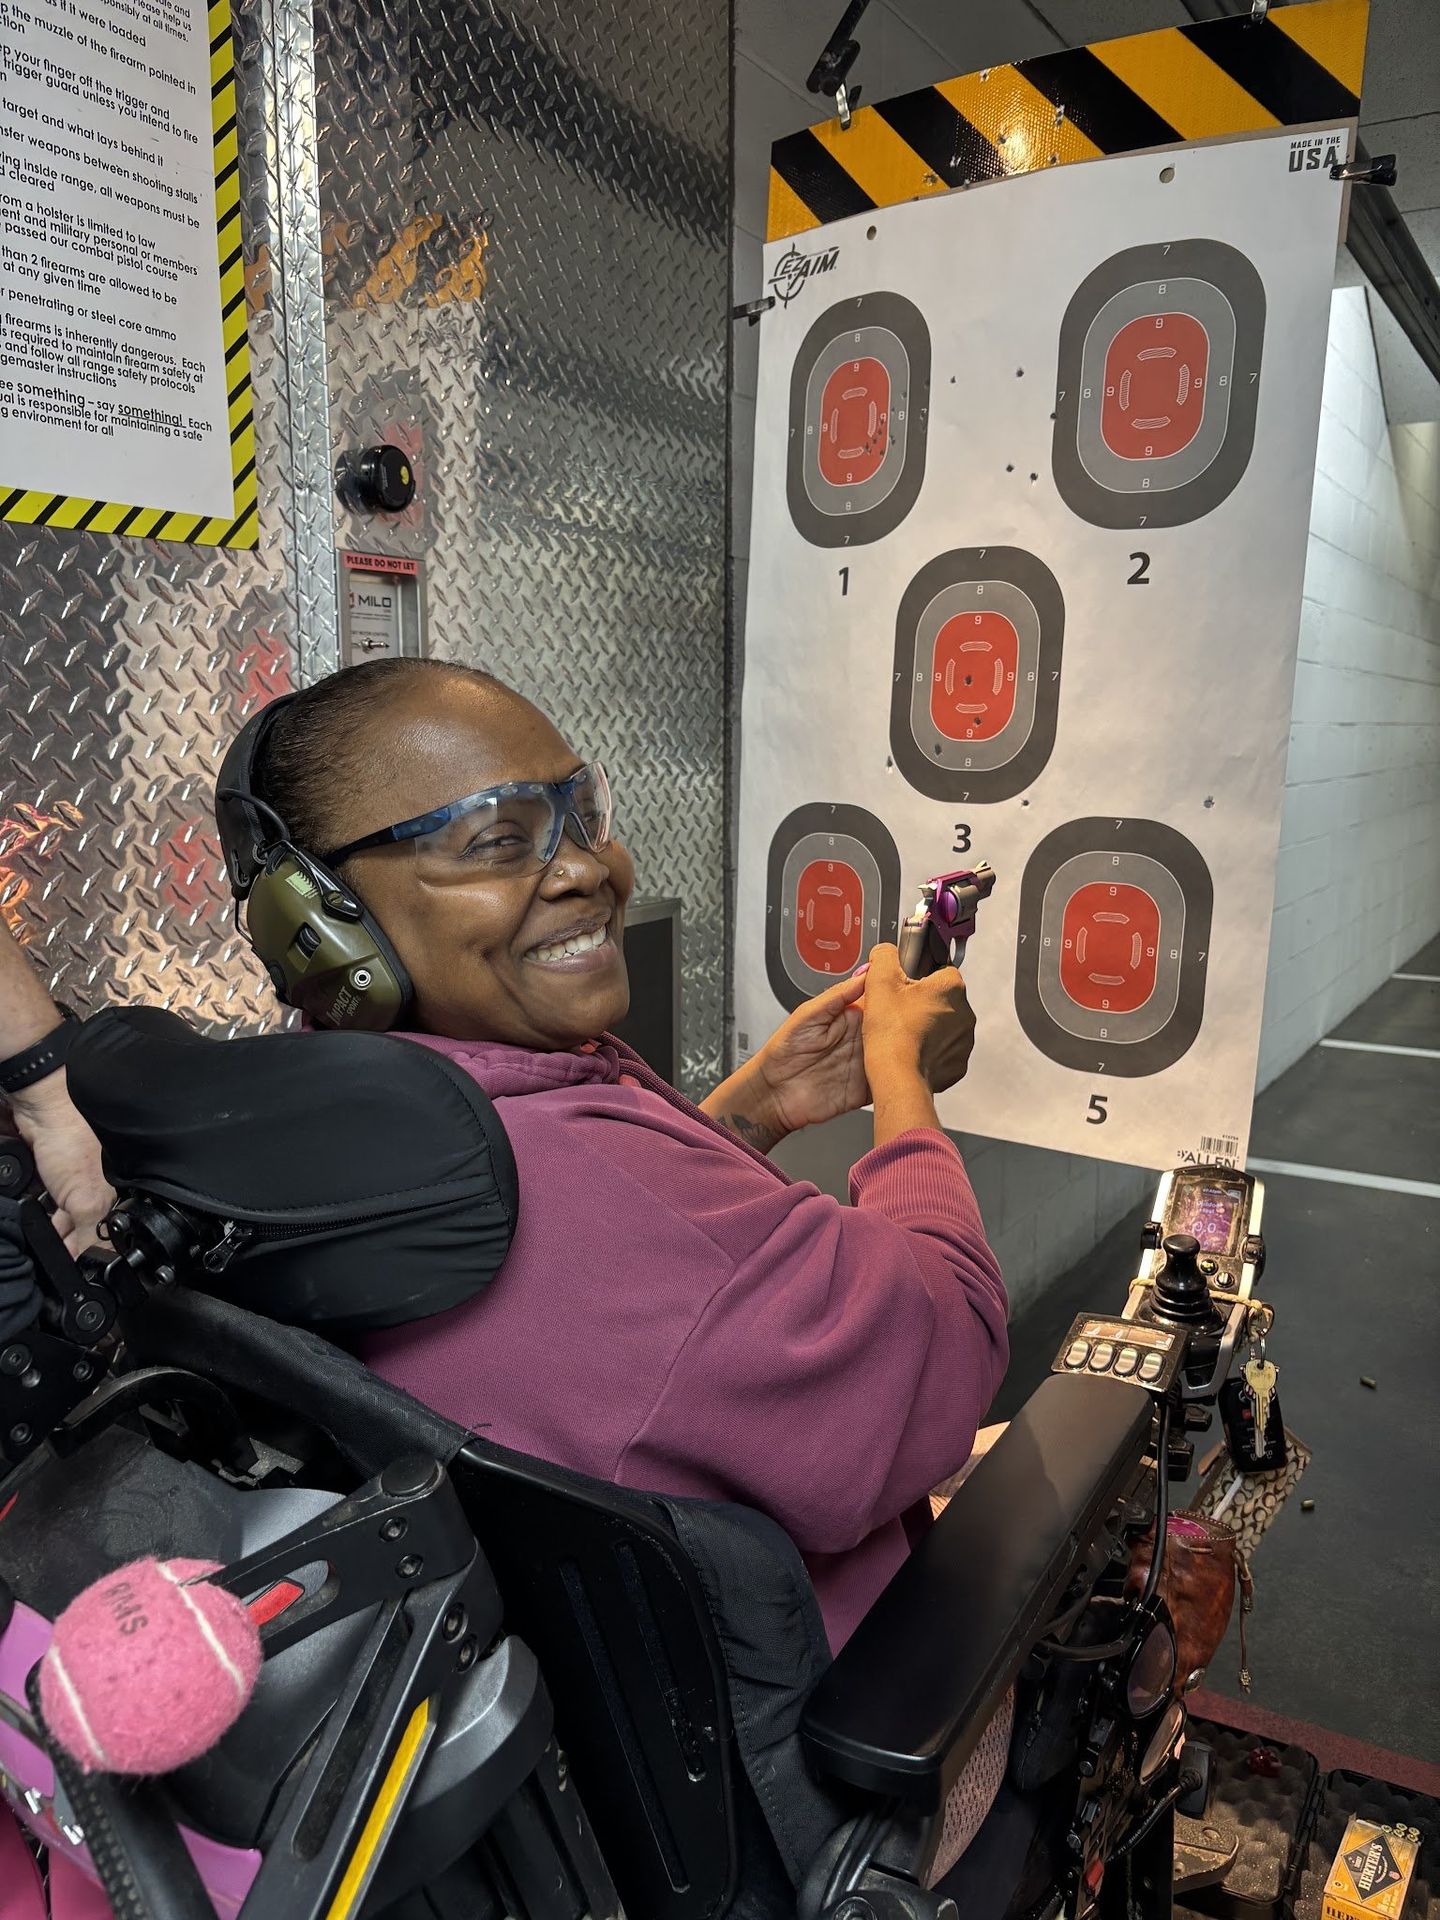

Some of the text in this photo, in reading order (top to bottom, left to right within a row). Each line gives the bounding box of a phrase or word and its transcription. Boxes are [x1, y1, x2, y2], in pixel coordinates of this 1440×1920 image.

[69, 2, 76, 15] it
[79, 10, 106, 28] were
[109, 20, 146, 47] loaded
[142, 15, 151, 24] at
[153, 20, 163, 30] all
[163, 9, 181, 27] help
[183, 22, 191, 31] us
[174, 5, 190, 18] and
[12, 4, 31, 22] the
[35, 17, 74, 40] muzzle
[77, 35, 87, 46] of
[90, 38, 107, 55] the
[110, 47, 146, 72] firearm
[149, 67, 185, 90] pointed
[188, 82, 196, 95] in
[3, 54, 42, 81] trigger
[46, 76, 79, 96] guard
[83, 90, 115, 110] unless
[118, 104, 137, 118] you
[140, 110, 170, 132] intend
[172, 124, 181, 137] to
[184, 129, 198, 144] fire
[14, 49, 40, 67] your
[44, 58, 76, 81] finger
[79, 75, 92, 88] off
[95, 79, 112, 96] the
[115, 88, 148, 113] trigger
[150, 105, 169, 120] and
[2, 97, 163, 167] target and what lays behind it
[1291, 136, 1341, 149] MADE IN THE
[28, 136, 80, 161] weapons
[84, 152, 129, 178] between
[132, 172, 173, 197] shooting
[176, 188, 198, 204] stalls
[1289, 146, 1339, 172] USA
[9, 166, 54, 192] cleared
[24, 158, 58, 179] inside
[61, 173, 97, 194] range,
[100, 186, 112, 198] all
[115, 191, 160, 214] weapons
[163, 209, 185, 223] must
[187, 215, 200, 229] be
[25, 202, 33, 211] a
[37, 202, 74, 223] holster
[77, 214, 85, 227] is
[88, 218, 123, 239] limited
[126, 231, 136, 243] to
[138, 234, 155, 249] law
[5, 222, 178, 281] passed our combat pistol course
[24, 215, 197, 275] and military personal or members
[1162, 245, 1171, 255] 7
[1, 245, 177, 305] than 2 firearms are allowed to be
[3, 261, 101, 295] at any given time
[1158, 284, 1167, 294] 8
[9, 289, 74, 316] penetrating
[77, 308, 88, 317] or
[91, 310, 116, 325] steel
[119, 319, 142, 332] core
[145, 326, 176, 341] ammo
[857, 298, 863, 308] 7
[1155, 318, 1164, 329] 9
[5, 313, 51, 334] firearms
[54, 324, 62, 337] is
[65, 327, 118, 354] inherently
[121, 342, 176, 369] dangerous.
[182, 357, 205, 372] Each
[11, 330, 59, 350] required
[62, 339, 73, 352] to
[76, 346, 122, 364] maintain
[124, 355, 159, 373] firearm
[162, 367, 191, 382] safety
[193, 374, 203, 383] at
[5, 342, 195, 393] and follow all range safety protocols
[57, 364, 117, 387] instructions
[12, 409, 81, 430] environment
[84, 420, 98, 433] for
[101, 425, 114, 436] all
[17, 383, 85, 410] something
[97, 401, 115, 414] say
[118, 404, 186, 428] something!
[189, 418, 212, 432] Each
[17, 394, 26, 406] is
[29, 399, 91, 422] responsible
[94, 410, 108, 422] for
[111, 416, 171, 437] maintaining
[173, 429, 180, 437] a
[183, 430, 202, 441] safe
[346, 556, 415, 570] PLEASE DO NOT LET
[979, 549, 986, 559] 7
[1127, 551, 1150, 585] 2
[838, 566, 849, 596] 1
[976, 585, 984, 595] 8
[358, 594, 392, 608] MILO
[974, 615, 982, 625] 9
[831, 805, 836, 814] 7
[1115, 820, 1123, 829] 7
[952, 823, 972, 853] 3
[1112, 856, 1120, 866] 8
[1109, 886, 1117, 896] 9
[326, 985, 352, 1026] IMPACT
[1085, 1094, 1108, 1125] 5
[1358, 1843, 1383, 1891] HERTER'S
